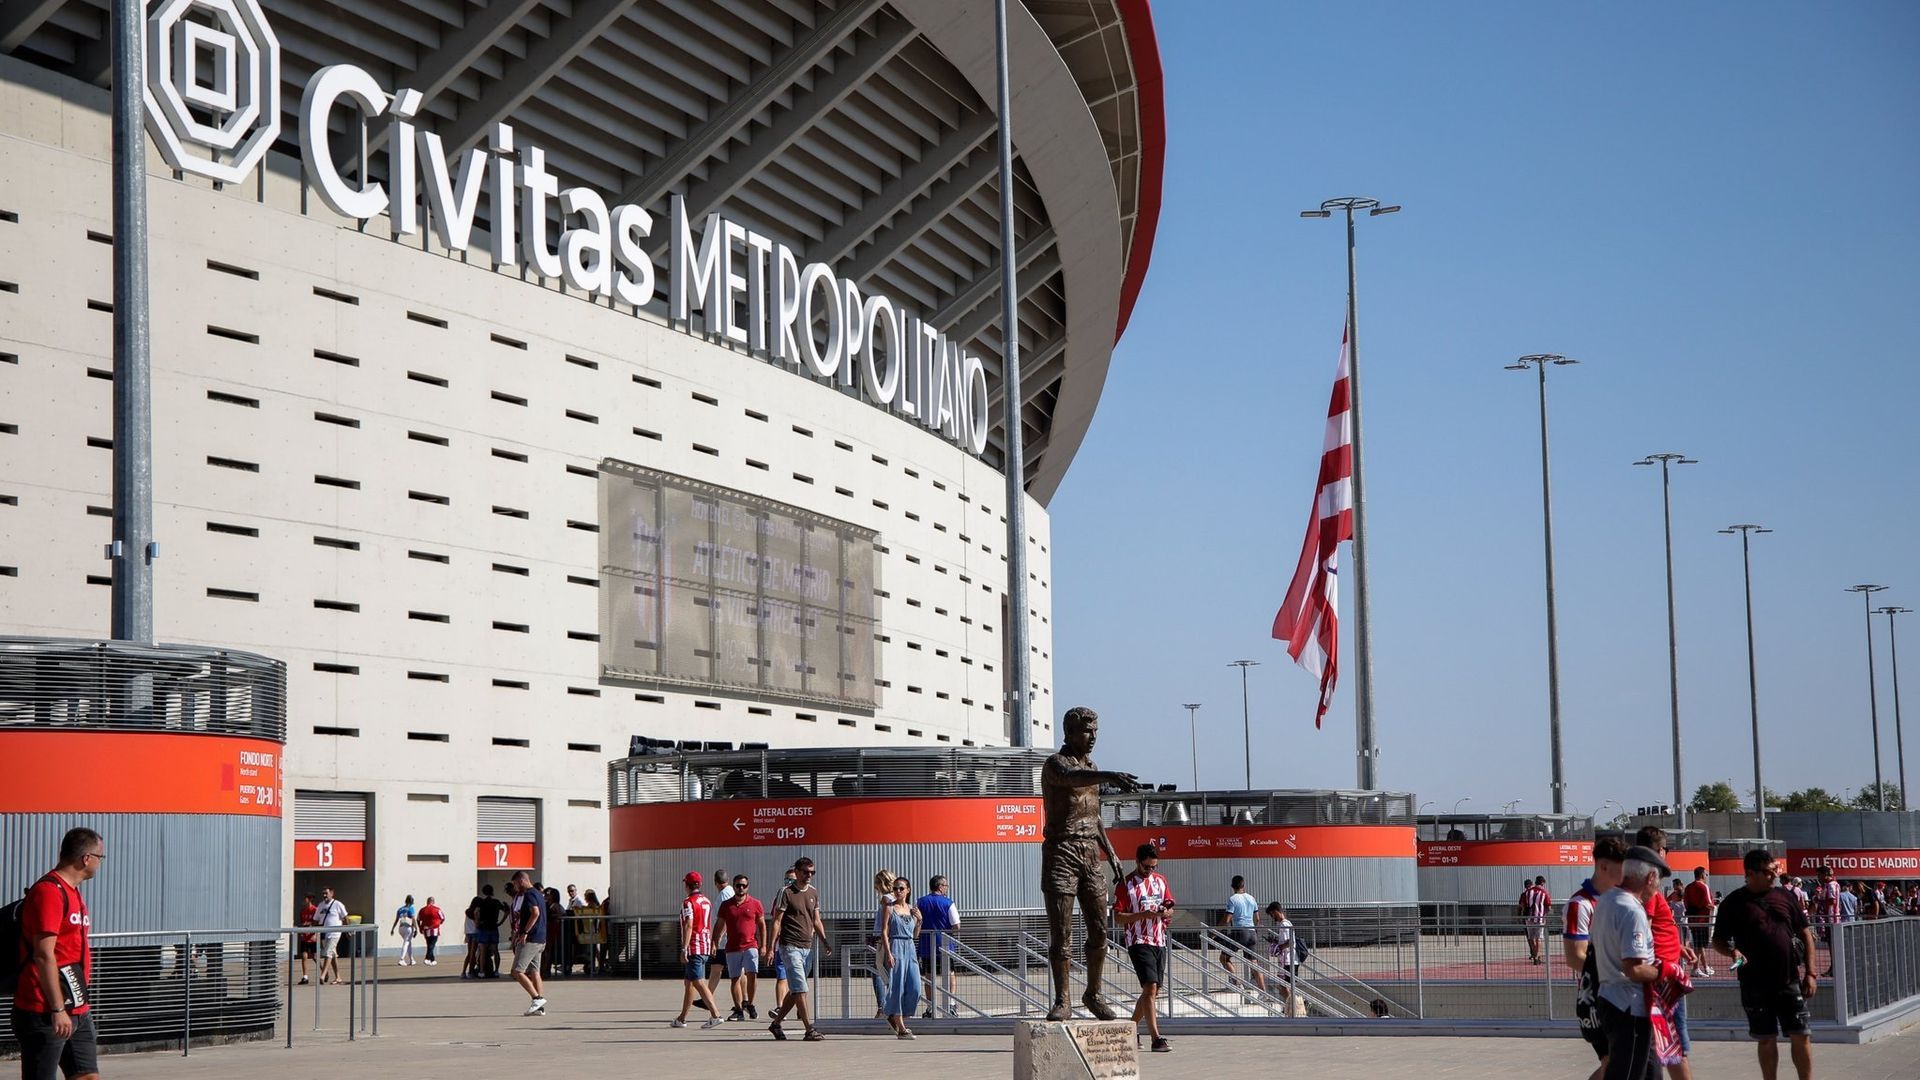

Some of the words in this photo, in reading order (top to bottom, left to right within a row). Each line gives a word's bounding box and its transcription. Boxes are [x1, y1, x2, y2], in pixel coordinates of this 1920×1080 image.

[299, 64, 656, 306] Cívitas
[671, 194, 989, 455] METROPOLITANO
[240, 751, 260, 767] FONDO
[256, 786, 274, 805] 20-30
[753, 808, 787, 817] LATERAL
[788, 807, 813, 816] OESTE
[996, 804, 1022, 814] LATERAL
[1023, 804, 1036, 814] ESTE
[777, 827, 805, 839] 01-19
[1015, 824, 1037, 836] 34-37
[316, 841, 333, 868] 13
[493, 843, 508, 867] 12
[1800, 855, 1858, 868] ATLÉTICO
[1860, 857, 1876, 868] DE
[1878, 857, 1918, 868] MADRID
[701, 903, 710, 928] 7
